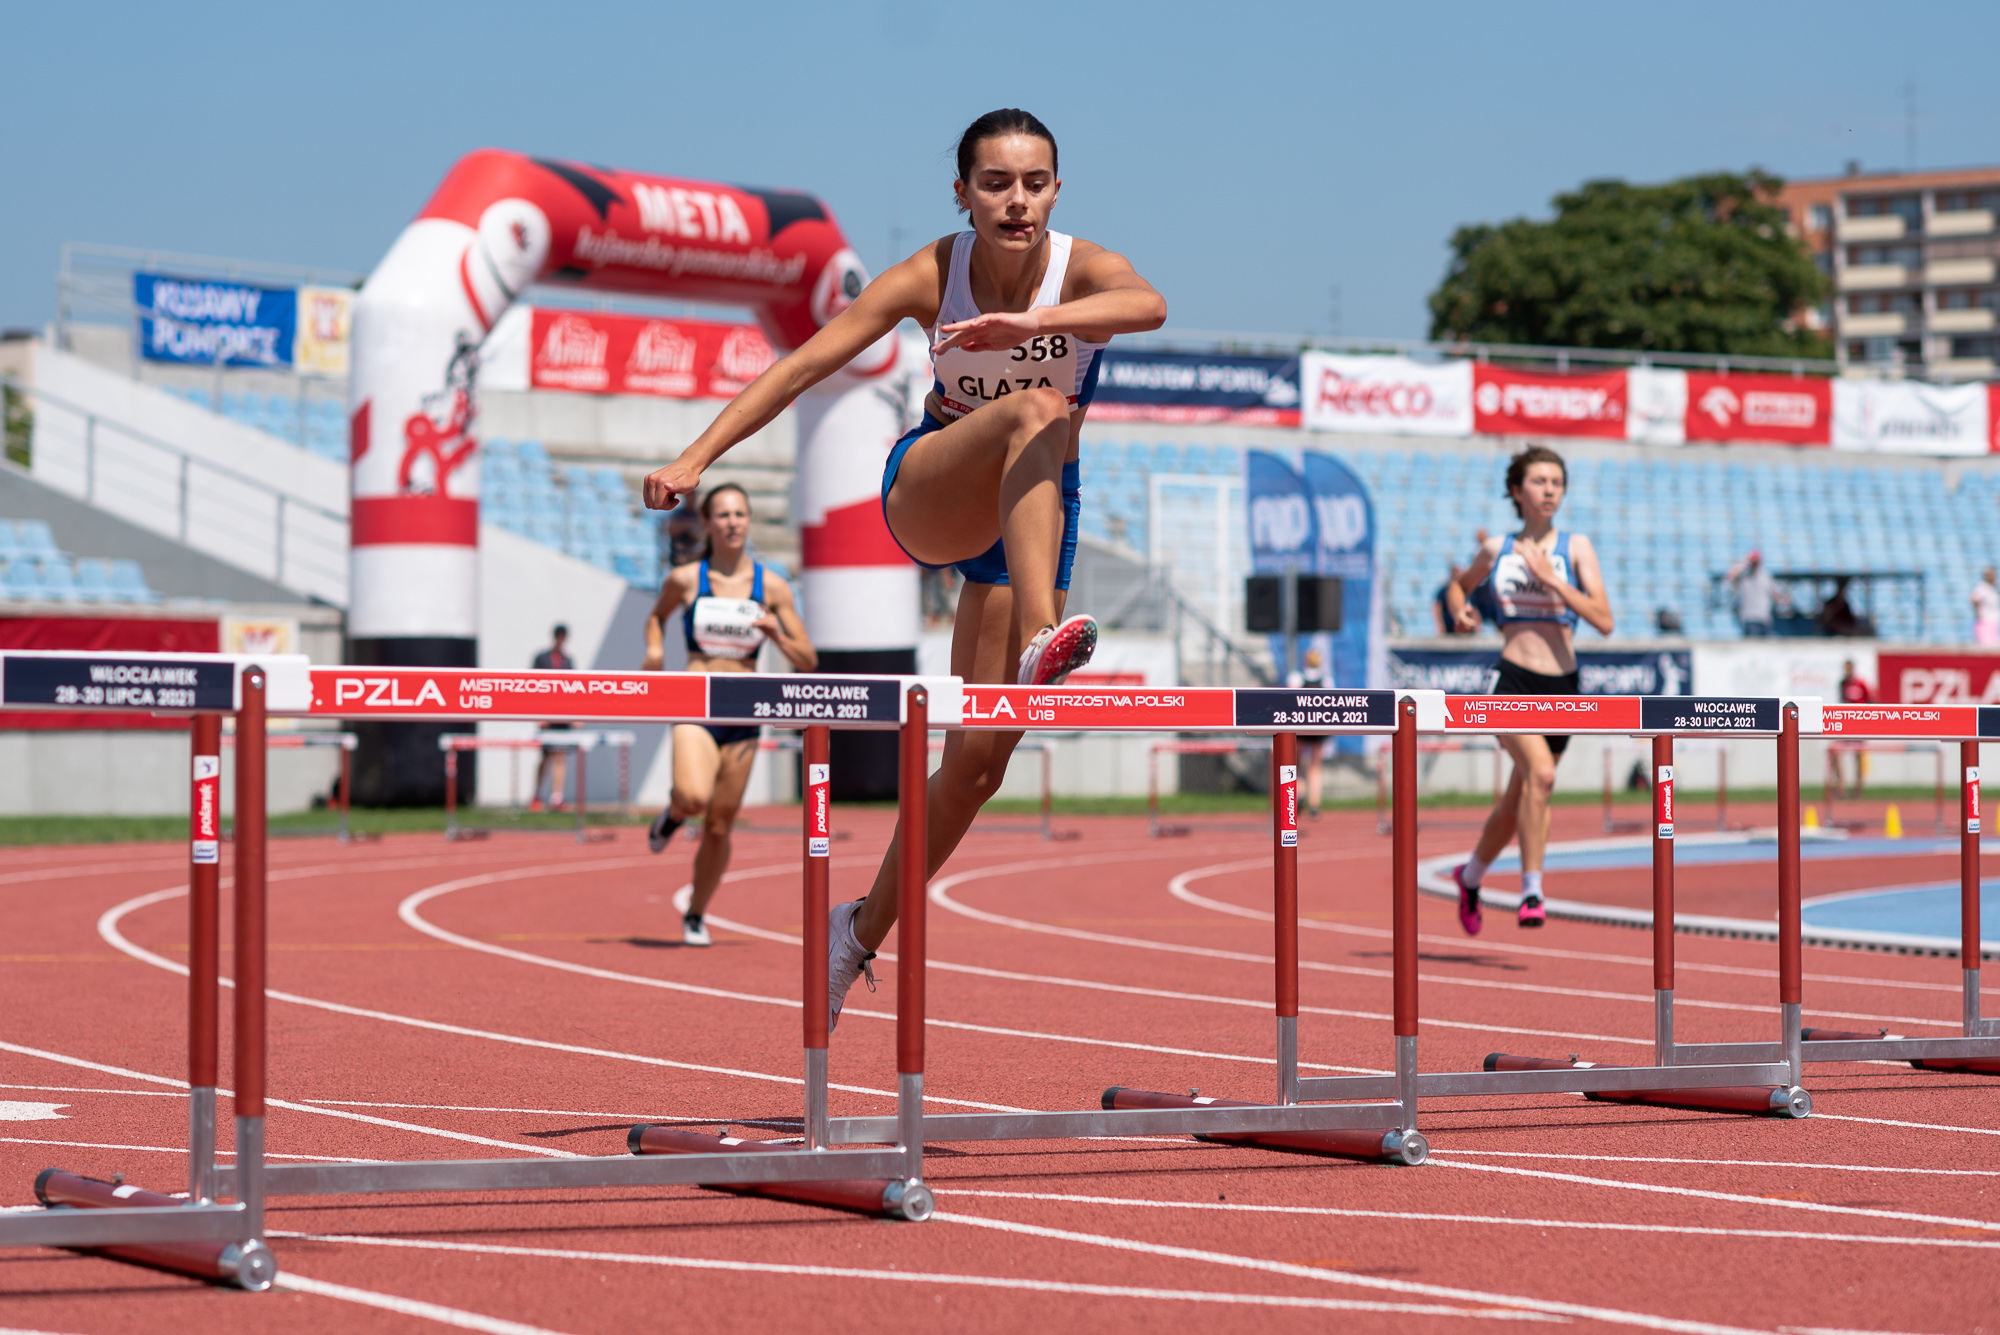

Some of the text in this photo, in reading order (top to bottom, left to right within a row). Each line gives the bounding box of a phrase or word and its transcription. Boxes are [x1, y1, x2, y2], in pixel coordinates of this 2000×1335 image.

[632, 182, 751, 245] META
[90, 665, 198, 686] WŁOCŁAWEK
[336, 678, 447, 706] PZLA
[459, 678, 648, 695] MISTRZOSTWA POLSKI
[782, 684, 869, 700] WŁOCŁAWEK
[55, 685, 196, 707] 28-30 LIPCA 2021
[459, 695, 493, 709] U18
[1028, 695, 1184, 707] MISTRZOSTWA POLSKI
[1296, 695, 1369, 707] WŁOCŁAWEK
[753, 702, 867, 719] 28-30 LIPCA 2021
[1463, 701, 1553, 712] MISTRZOSTWA
[1555, 702, 1598, 712] POLSKI
[1694, 703, 1756, 713] WŁOCŁAWEK
[1028, 709, 1055, 721] U18
[1273, 711, 1367, 723] 28-30 LIPCA 2021
[1463, 713, 1487, 724] U18
[1674, 716, 1755, 728] 28-30 LIPCA 2021
[1823, 710, 1940, 721] MISTRZOSTWA POLSKI
[199, 783, 215, 837] polanik
[815, 786, 828, 834] polanik
[1286, 786, 1297, 826] polanik
[1664, 784, 1673, 821] polanik
